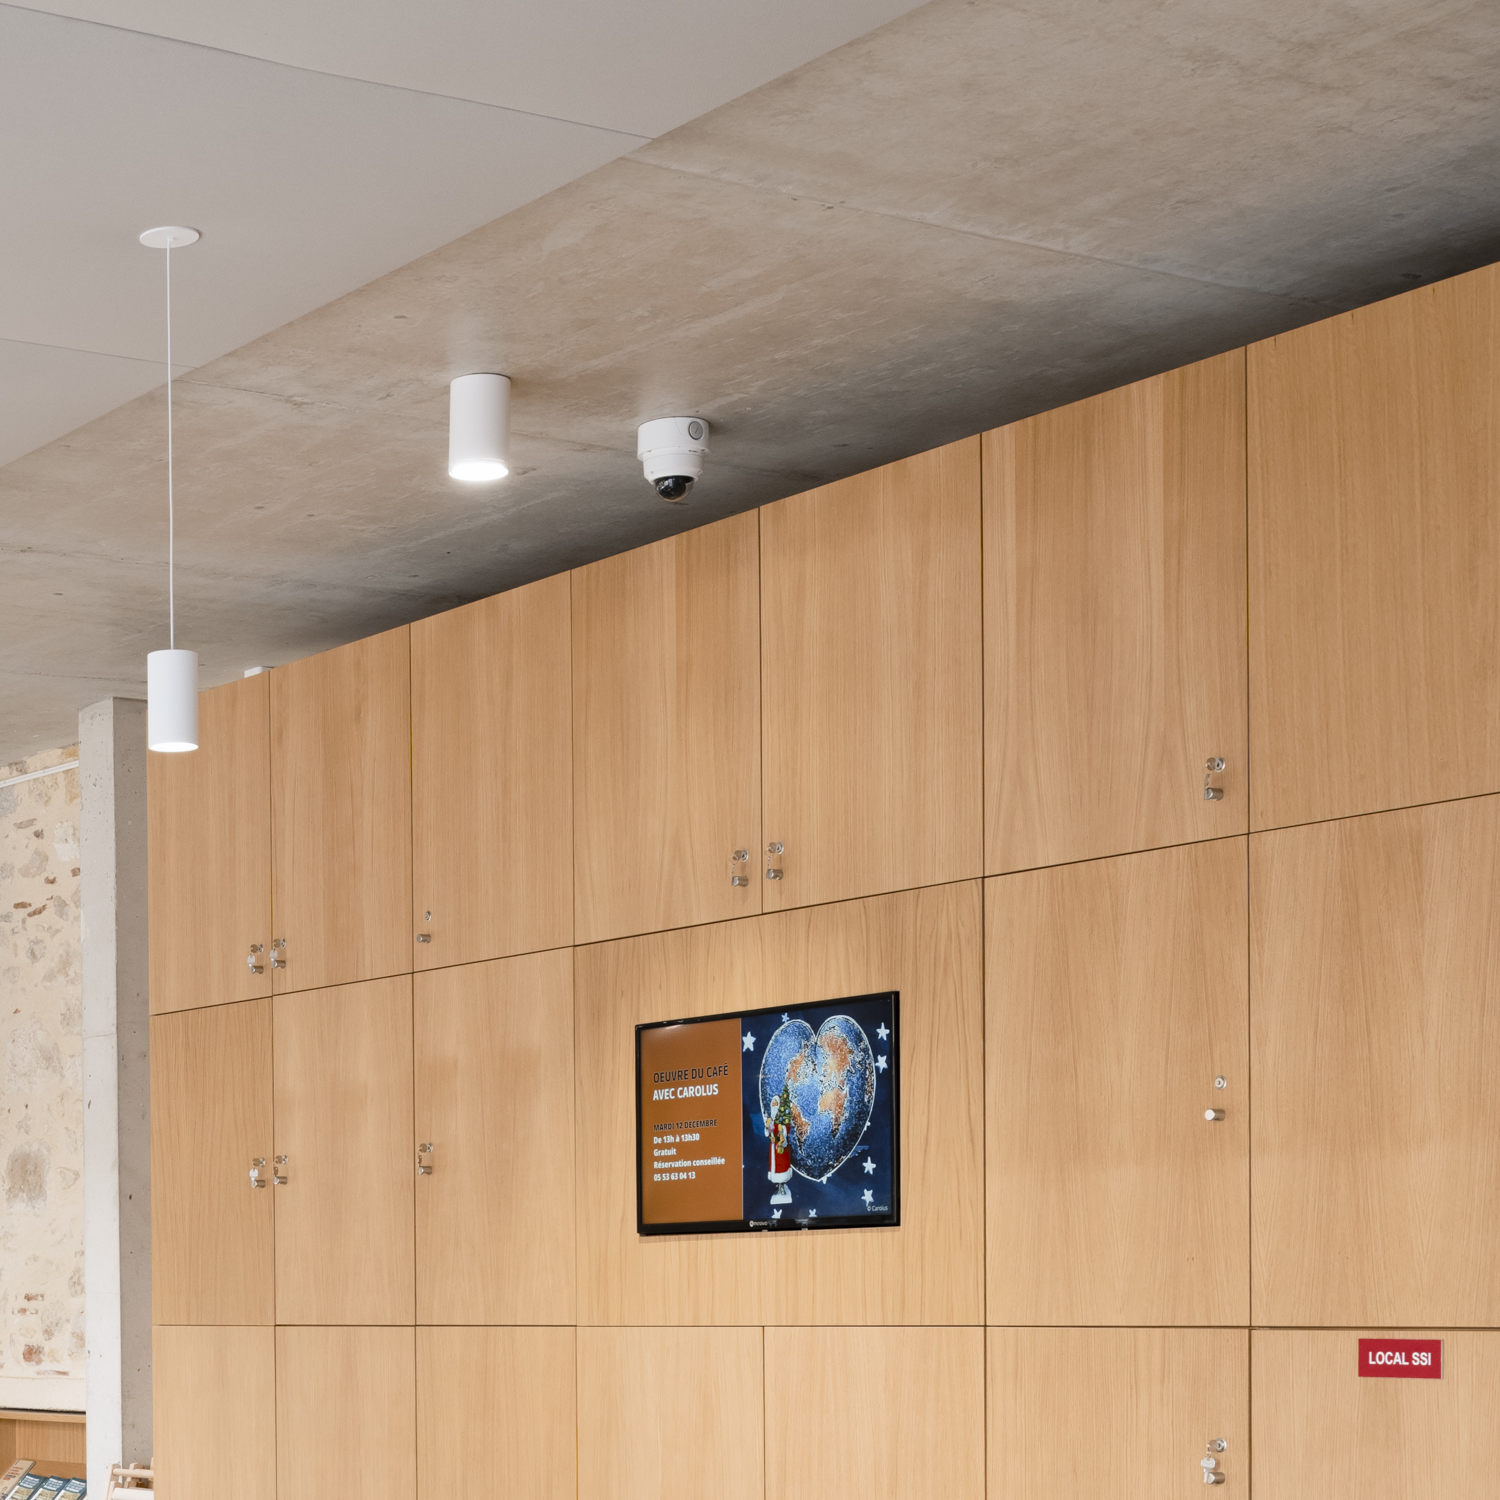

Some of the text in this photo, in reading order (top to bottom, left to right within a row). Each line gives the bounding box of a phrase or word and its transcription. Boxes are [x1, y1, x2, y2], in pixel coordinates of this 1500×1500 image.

[653, 1062, 729, 1083] OEUVRE DU CAFÉ
[652, 1083, 719, 1101] AVEC CAROLUS
[653, 1123, 674, 1131] MARDI
[684, 1119, 717, 1129] DÉCEMBRE
[653, 1133, 700, 1144] De 13h à 13h30
[653, 1147, 677, 1157] Gratuit
[653, 1156, 725, 1169] Réservation conseillée
[653, 1171, 696, 1181] 05 53 63 04 13
[1368, 1351, 1432, 1366] LOCAL SSI
